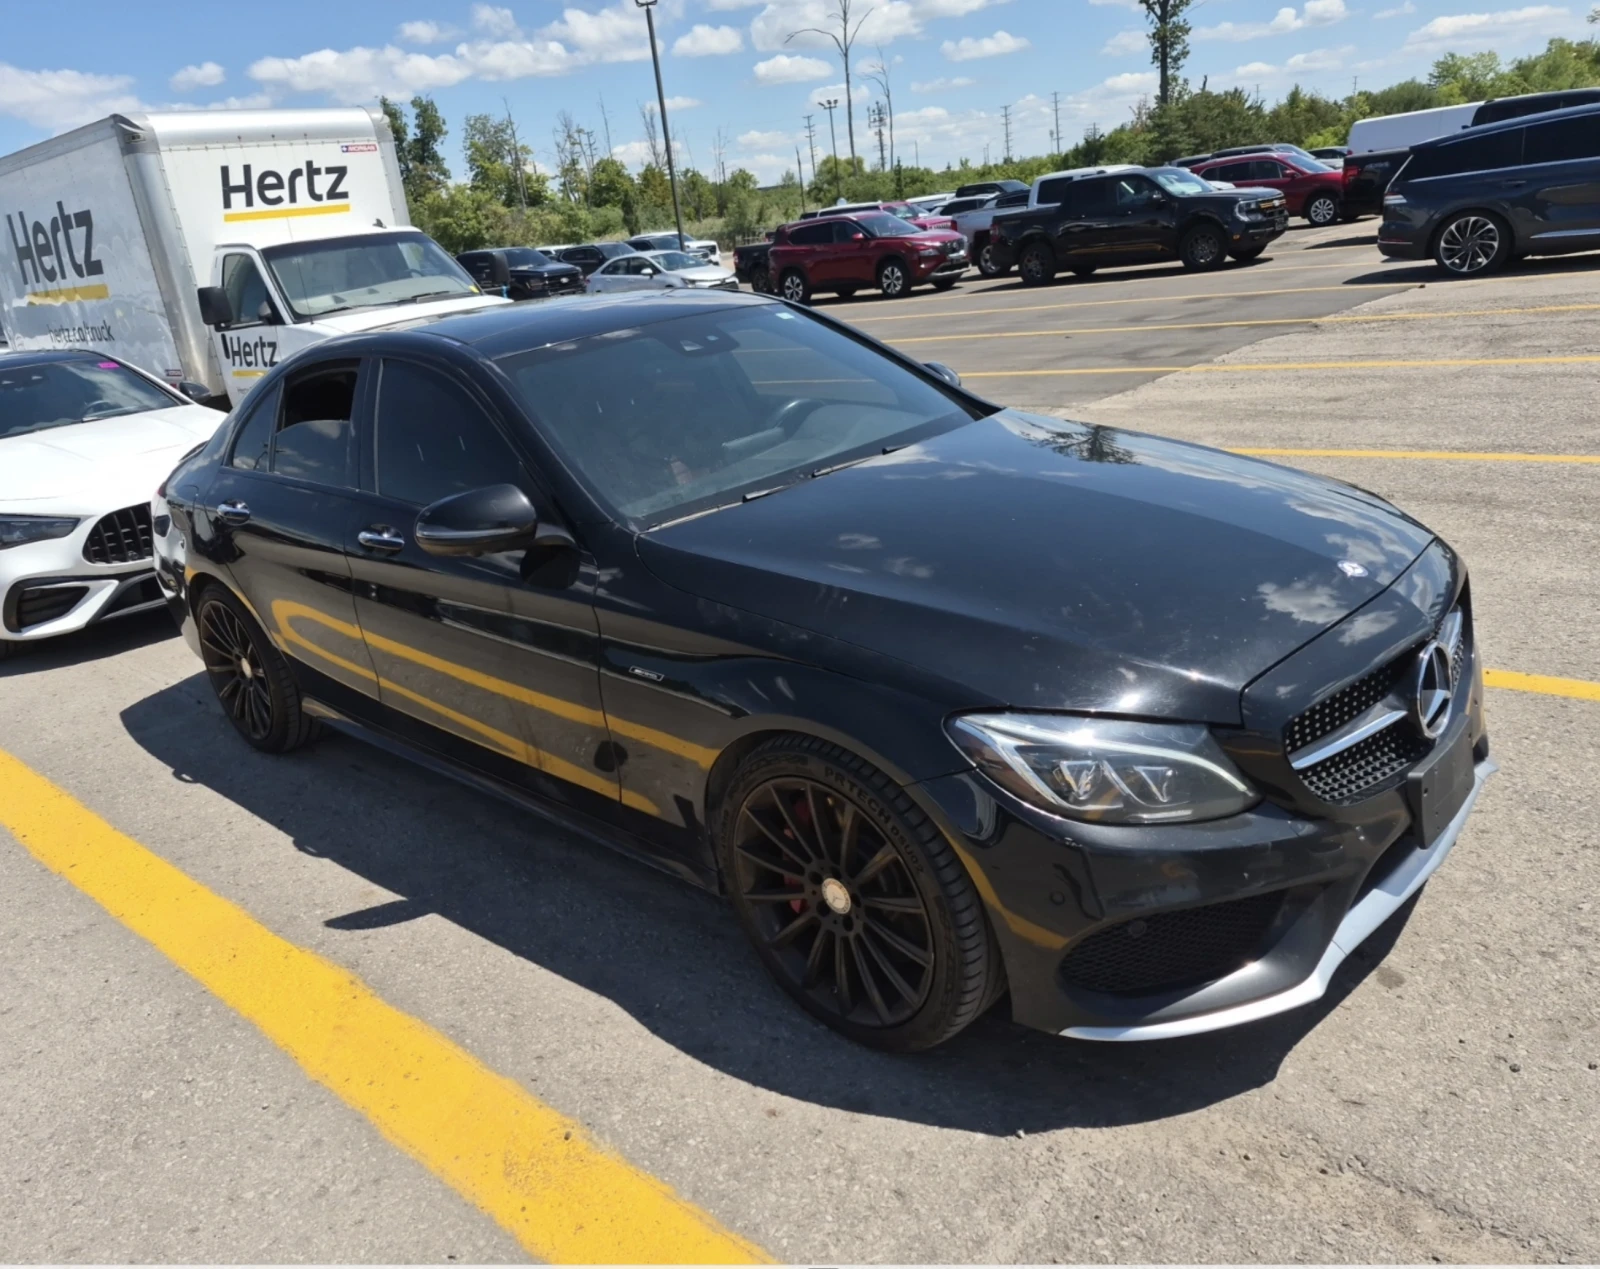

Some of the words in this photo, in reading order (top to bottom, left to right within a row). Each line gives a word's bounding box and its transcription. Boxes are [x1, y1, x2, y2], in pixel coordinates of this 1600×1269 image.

[220, 160, 349, 209] Hertz
[6, 200, 104, 286] Hertz
[229, 336, 279, 368] Hertz
